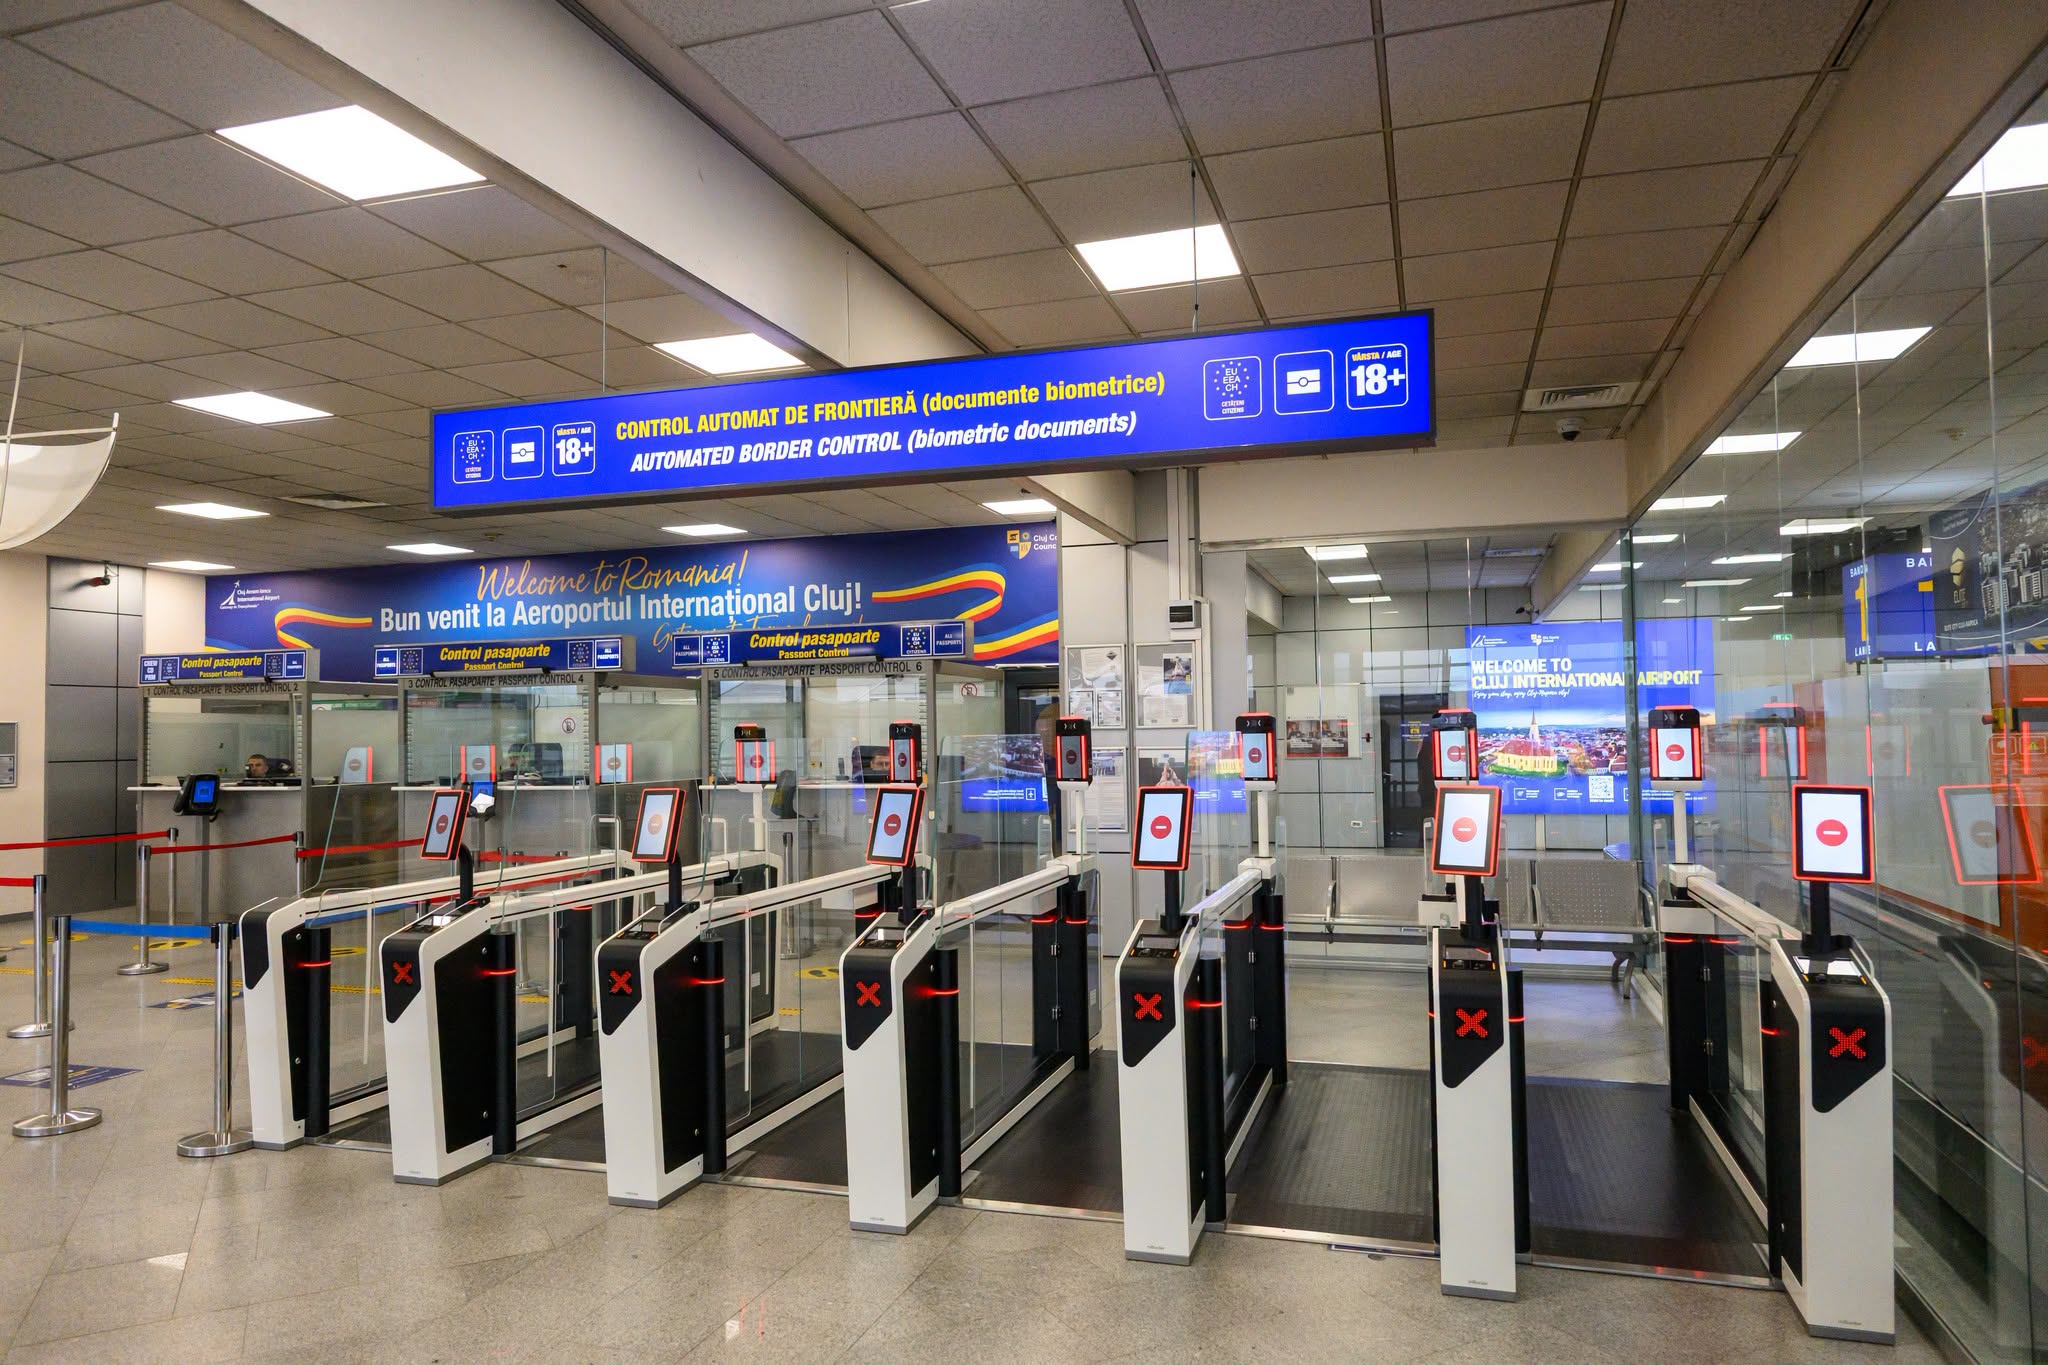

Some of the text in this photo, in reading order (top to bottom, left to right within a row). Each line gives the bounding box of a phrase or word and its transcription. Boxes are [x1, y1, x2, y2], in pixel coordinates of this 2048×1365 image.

[1387, 350, 1402, 359] AGE
[1223, 375, 1241, 384] EEA
[1226, 368, 1238, 376] EU
[1351, 363, 1405, 396] 18+
[1225, 383, 1238, 392] CH
[616, 371, 1165, 441] CONTROL AUTOMAT DE FRONTIERĂ (documente biometrice)
[466, 446, 480, 454] EEA
[630, 411, 1137, 473] AUTOMATED BORDER CONTROL (biometric documents)
[555, 437, 594, 465] 18+
[1033, 535, 1047, 543] Cluj
[476, 549, 749, 601] Welcome to Romania!
[380, 607, 421, 632] Bun
[426, 603, 481, 631] venit
[486, 601, 506, 627] la
[512, 594, 632, 629] Aeroportul
[640, 584, 796, 624] Internațional
[803, 582, 861, 616] Cluj!
[1855, 577, 1867, 642] 1
[750, 628, 881, 649] Control pasapoarte
[440, 643, 551, 661] Control pasapoarte
[778, 647, 849, 660] Passport Control
[181, 656, 213, 669] Control
[213, 654, 262, 669] pasapoarte
[498, 660, 524, 669] Control
[1471, 658, 1572, 674] WELCOME TO
[199, 669, 244, 678] Passport Control
[713, 668, 719, 679] 5
[721, 667, 761, 679] CONTROL
[819, 663, 867, 676] PASSPORT
[868, 661, 911, 674] CONTROL
[915, 661, 922, 672] 6
[153, 686, 181, 696] CONTROL
[224, 683, 259, 694] PASSPORT
[259, 682, 293, 693] CONTROL
[293, 682, 299, 691] 2
[408, 680, 413, 689] 3
[415, 678, 448, 689] CONTROL
[498, 674, 538, 686] PASSPORT
[538, 673, 577, 685] CONTROL
[578, 674, 584, 683] 4
[1471, 674, 1509, 690] CLUJ
